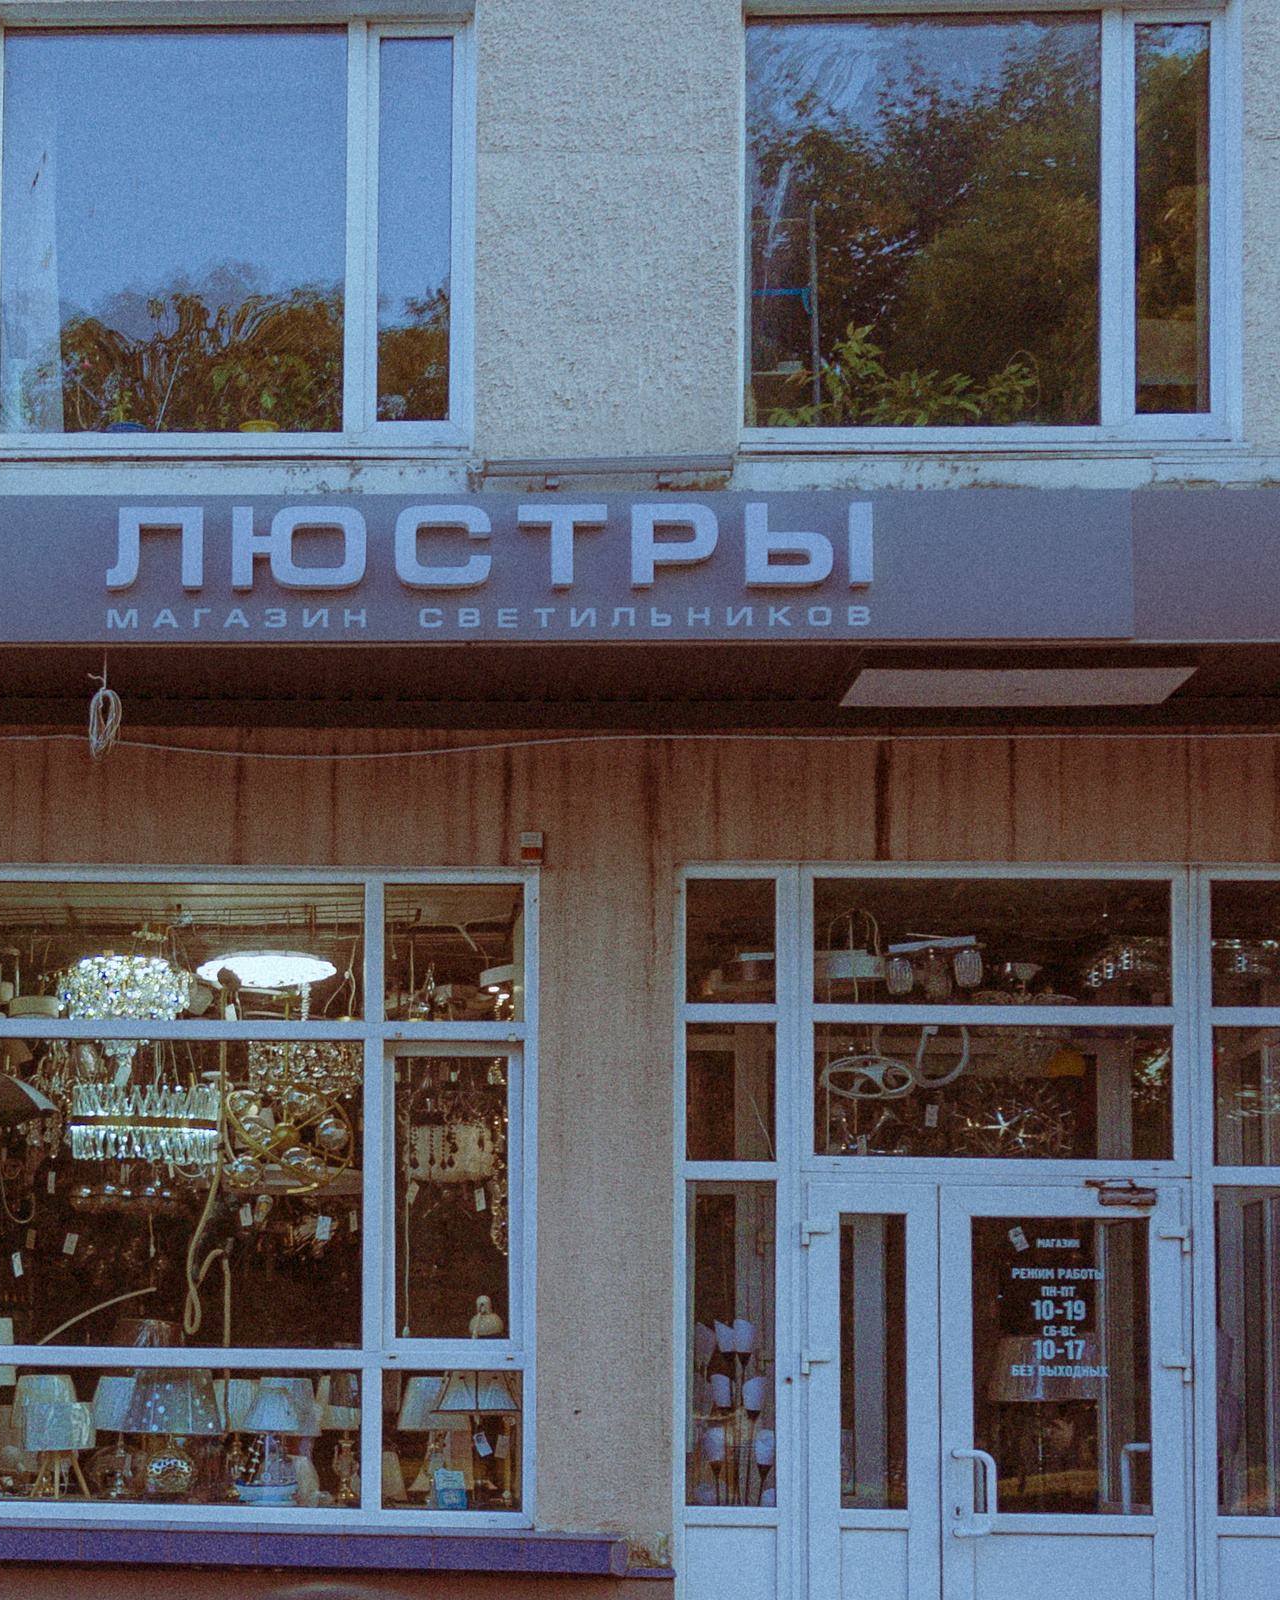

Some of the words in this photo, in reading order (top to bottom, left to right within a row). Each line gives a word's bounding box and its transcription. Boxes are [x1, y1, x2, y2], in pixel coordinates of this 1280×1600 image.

[106, 501, 873, 590] ЛЮСТРЫ
[106, 608, 367, 629] МАГАЗИН
[418, 606, 872, 629] СВЕТИЛЬНИКОВ
[1036, 1238, 1080, 1249] МАГАЗИН
[1012, 1267, 1055, 1280] РЕЖИМ
[1057, 1267, 1105, 1280] РАБОТЫ
[1041, 1285, 1077, 1297] ПН-ПТ
[1031, 1299, 1086, 1321] 10-19
[1043, 1325, 1076, 1337] СБ-ВС
[1033, 1339, 1087, 1360] 10-17
[1011, 1364, 1035, 1377] БЕЗ
[1038, 1364, 1109, 1379] ВЫХОДНЫХ
